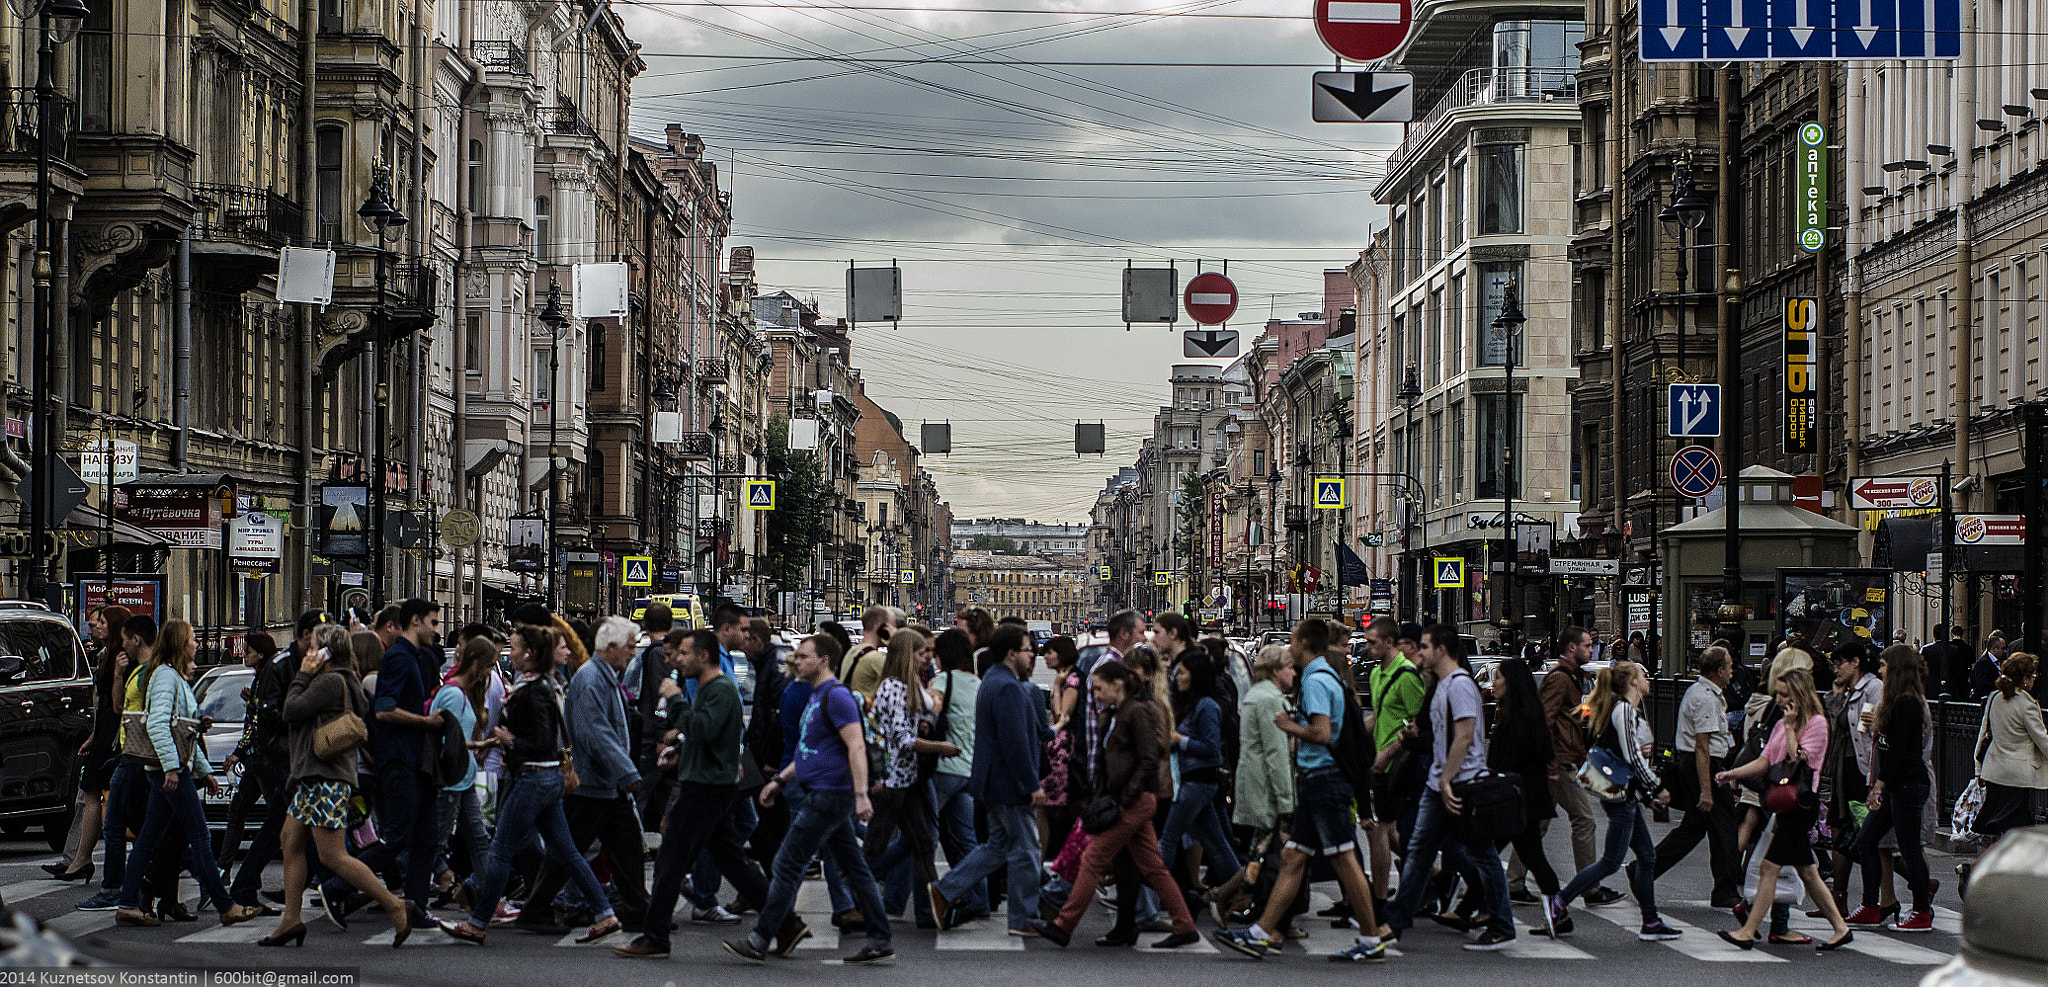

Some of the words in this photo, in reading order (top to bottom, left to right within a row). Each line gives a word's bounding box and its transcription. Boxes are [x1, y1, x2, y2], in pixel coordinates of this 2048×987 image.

[1807, 149, 1818, 225] аптека
[1806, 233, 1819, 241] 24
[1788, 398, 1799, 439] баров
[83, 455, 100, 464] НА
[1910, 480, 1932, 494] BURGER
[1912, 486, 1934, 502] KING
[142, 507, 201, 520] Путёвочка
[1960, 518, 1981, 532] BURGER
[1961, 524, 1983, 540] KING
[88, 585, 106, 593] Мой
[112, 586, 143, 594] ервый!
